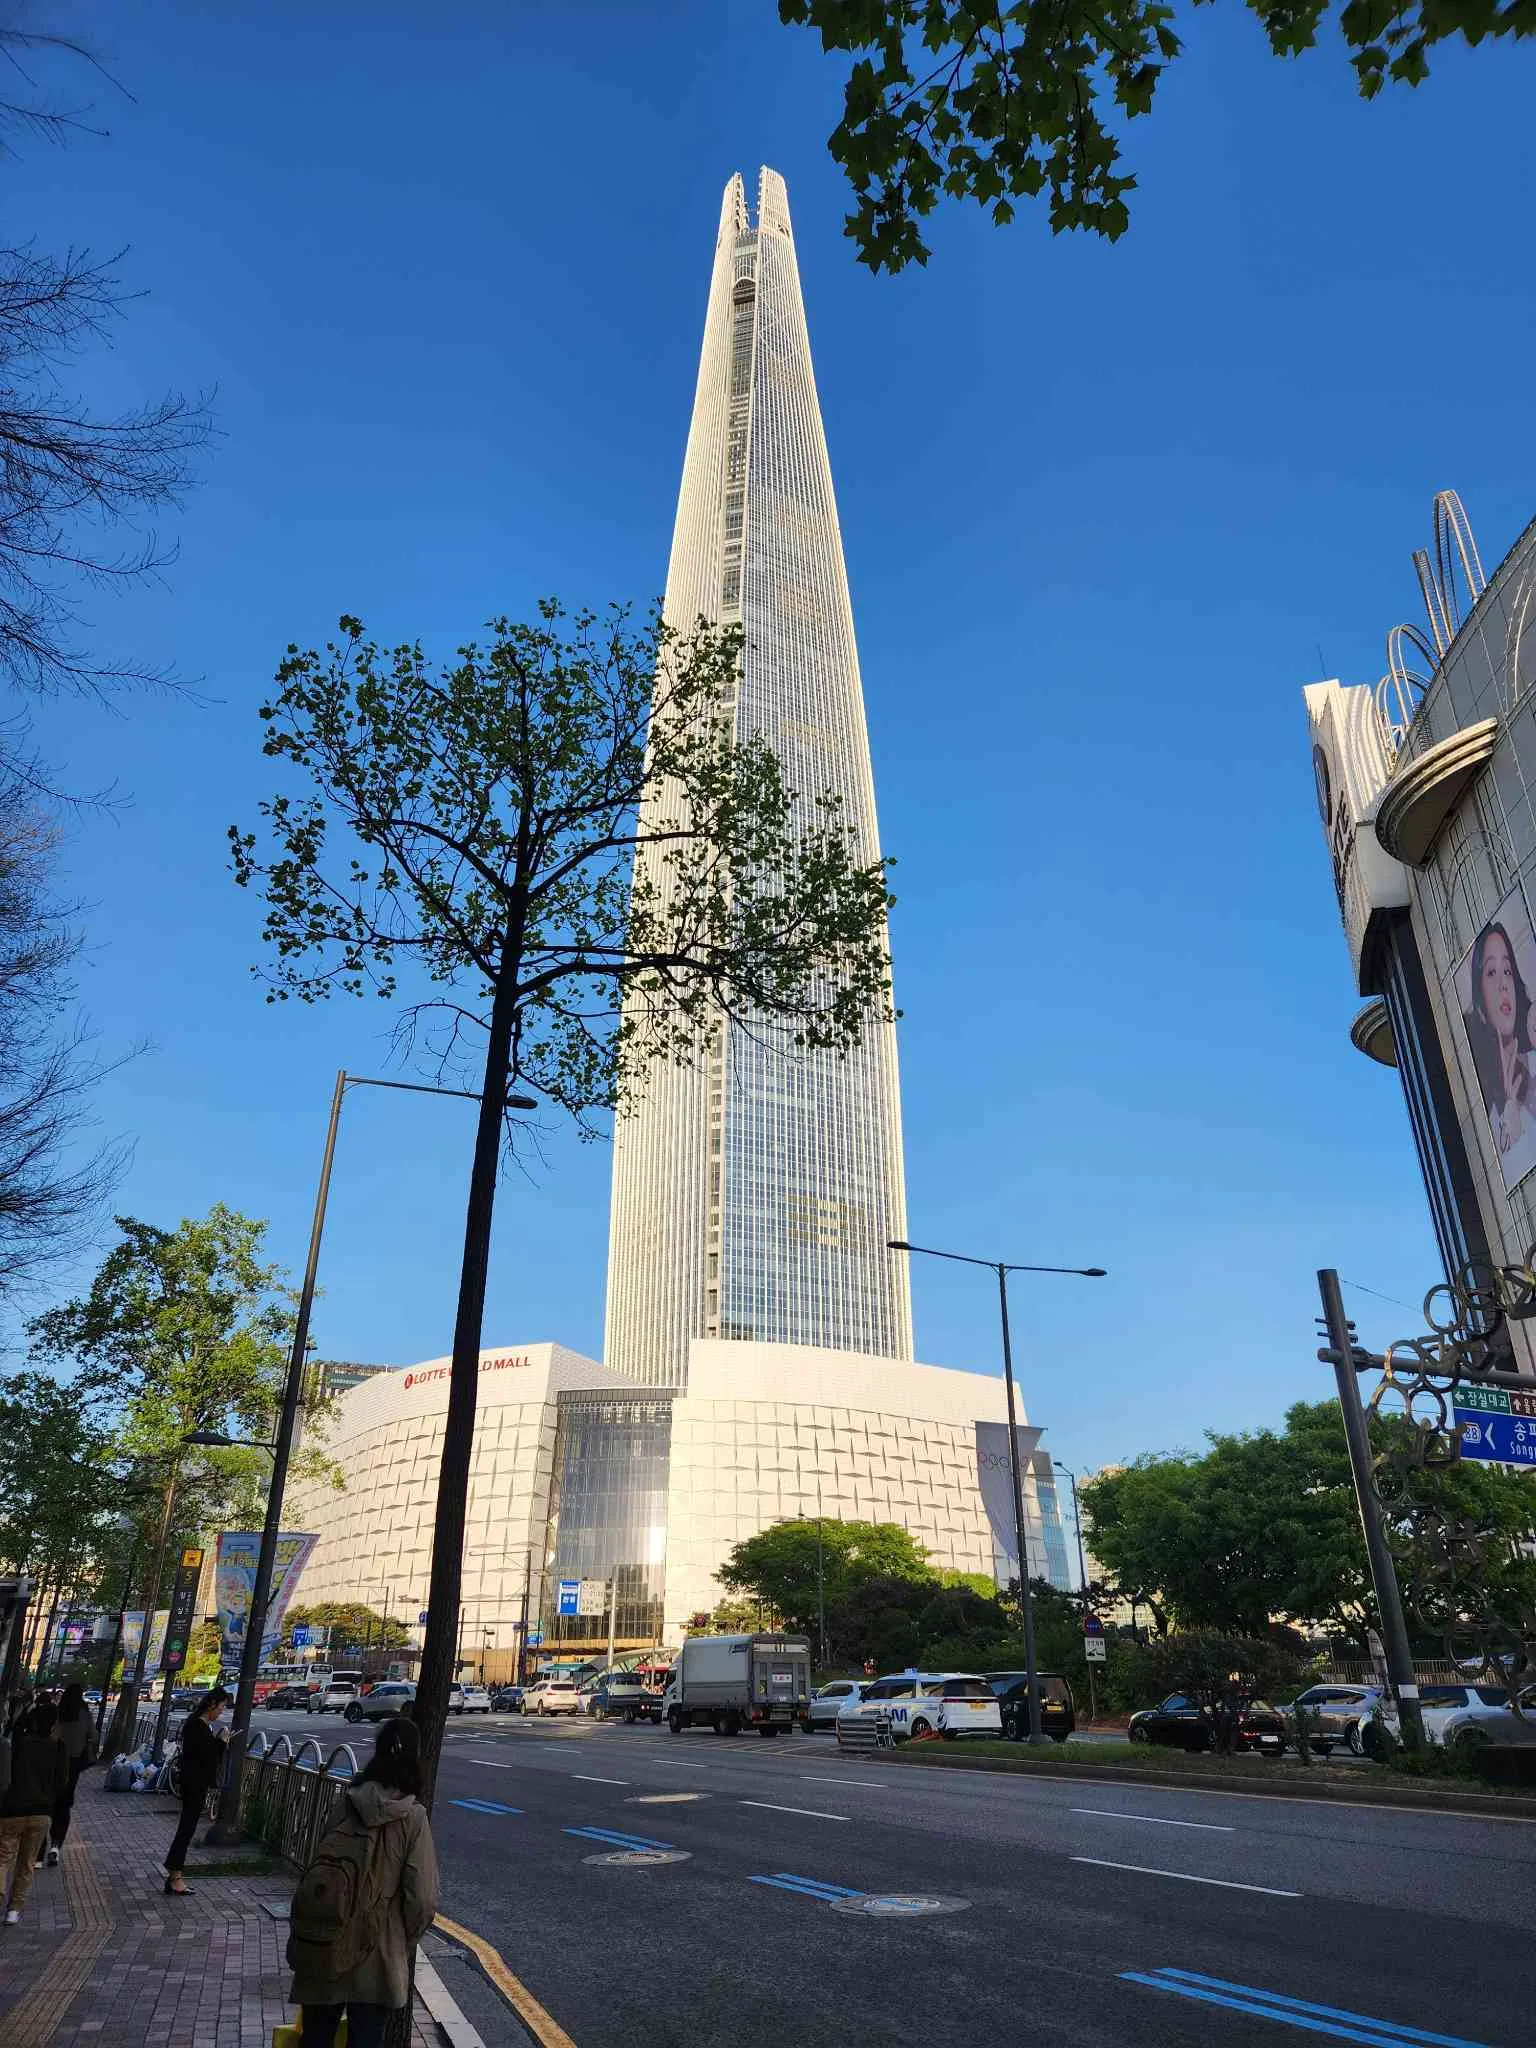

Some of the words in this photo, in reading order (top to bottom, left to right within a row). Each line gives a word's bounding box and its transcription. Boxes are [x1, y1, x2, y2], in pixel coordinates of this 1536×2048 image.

[413, 1367, 447, 1384] LOTTE
[493, 1356, 532, 1370] MALL
[1468, 1391, 1509, 1408] 잠실대교
[1510, 1441, 1536, 1460] Song
